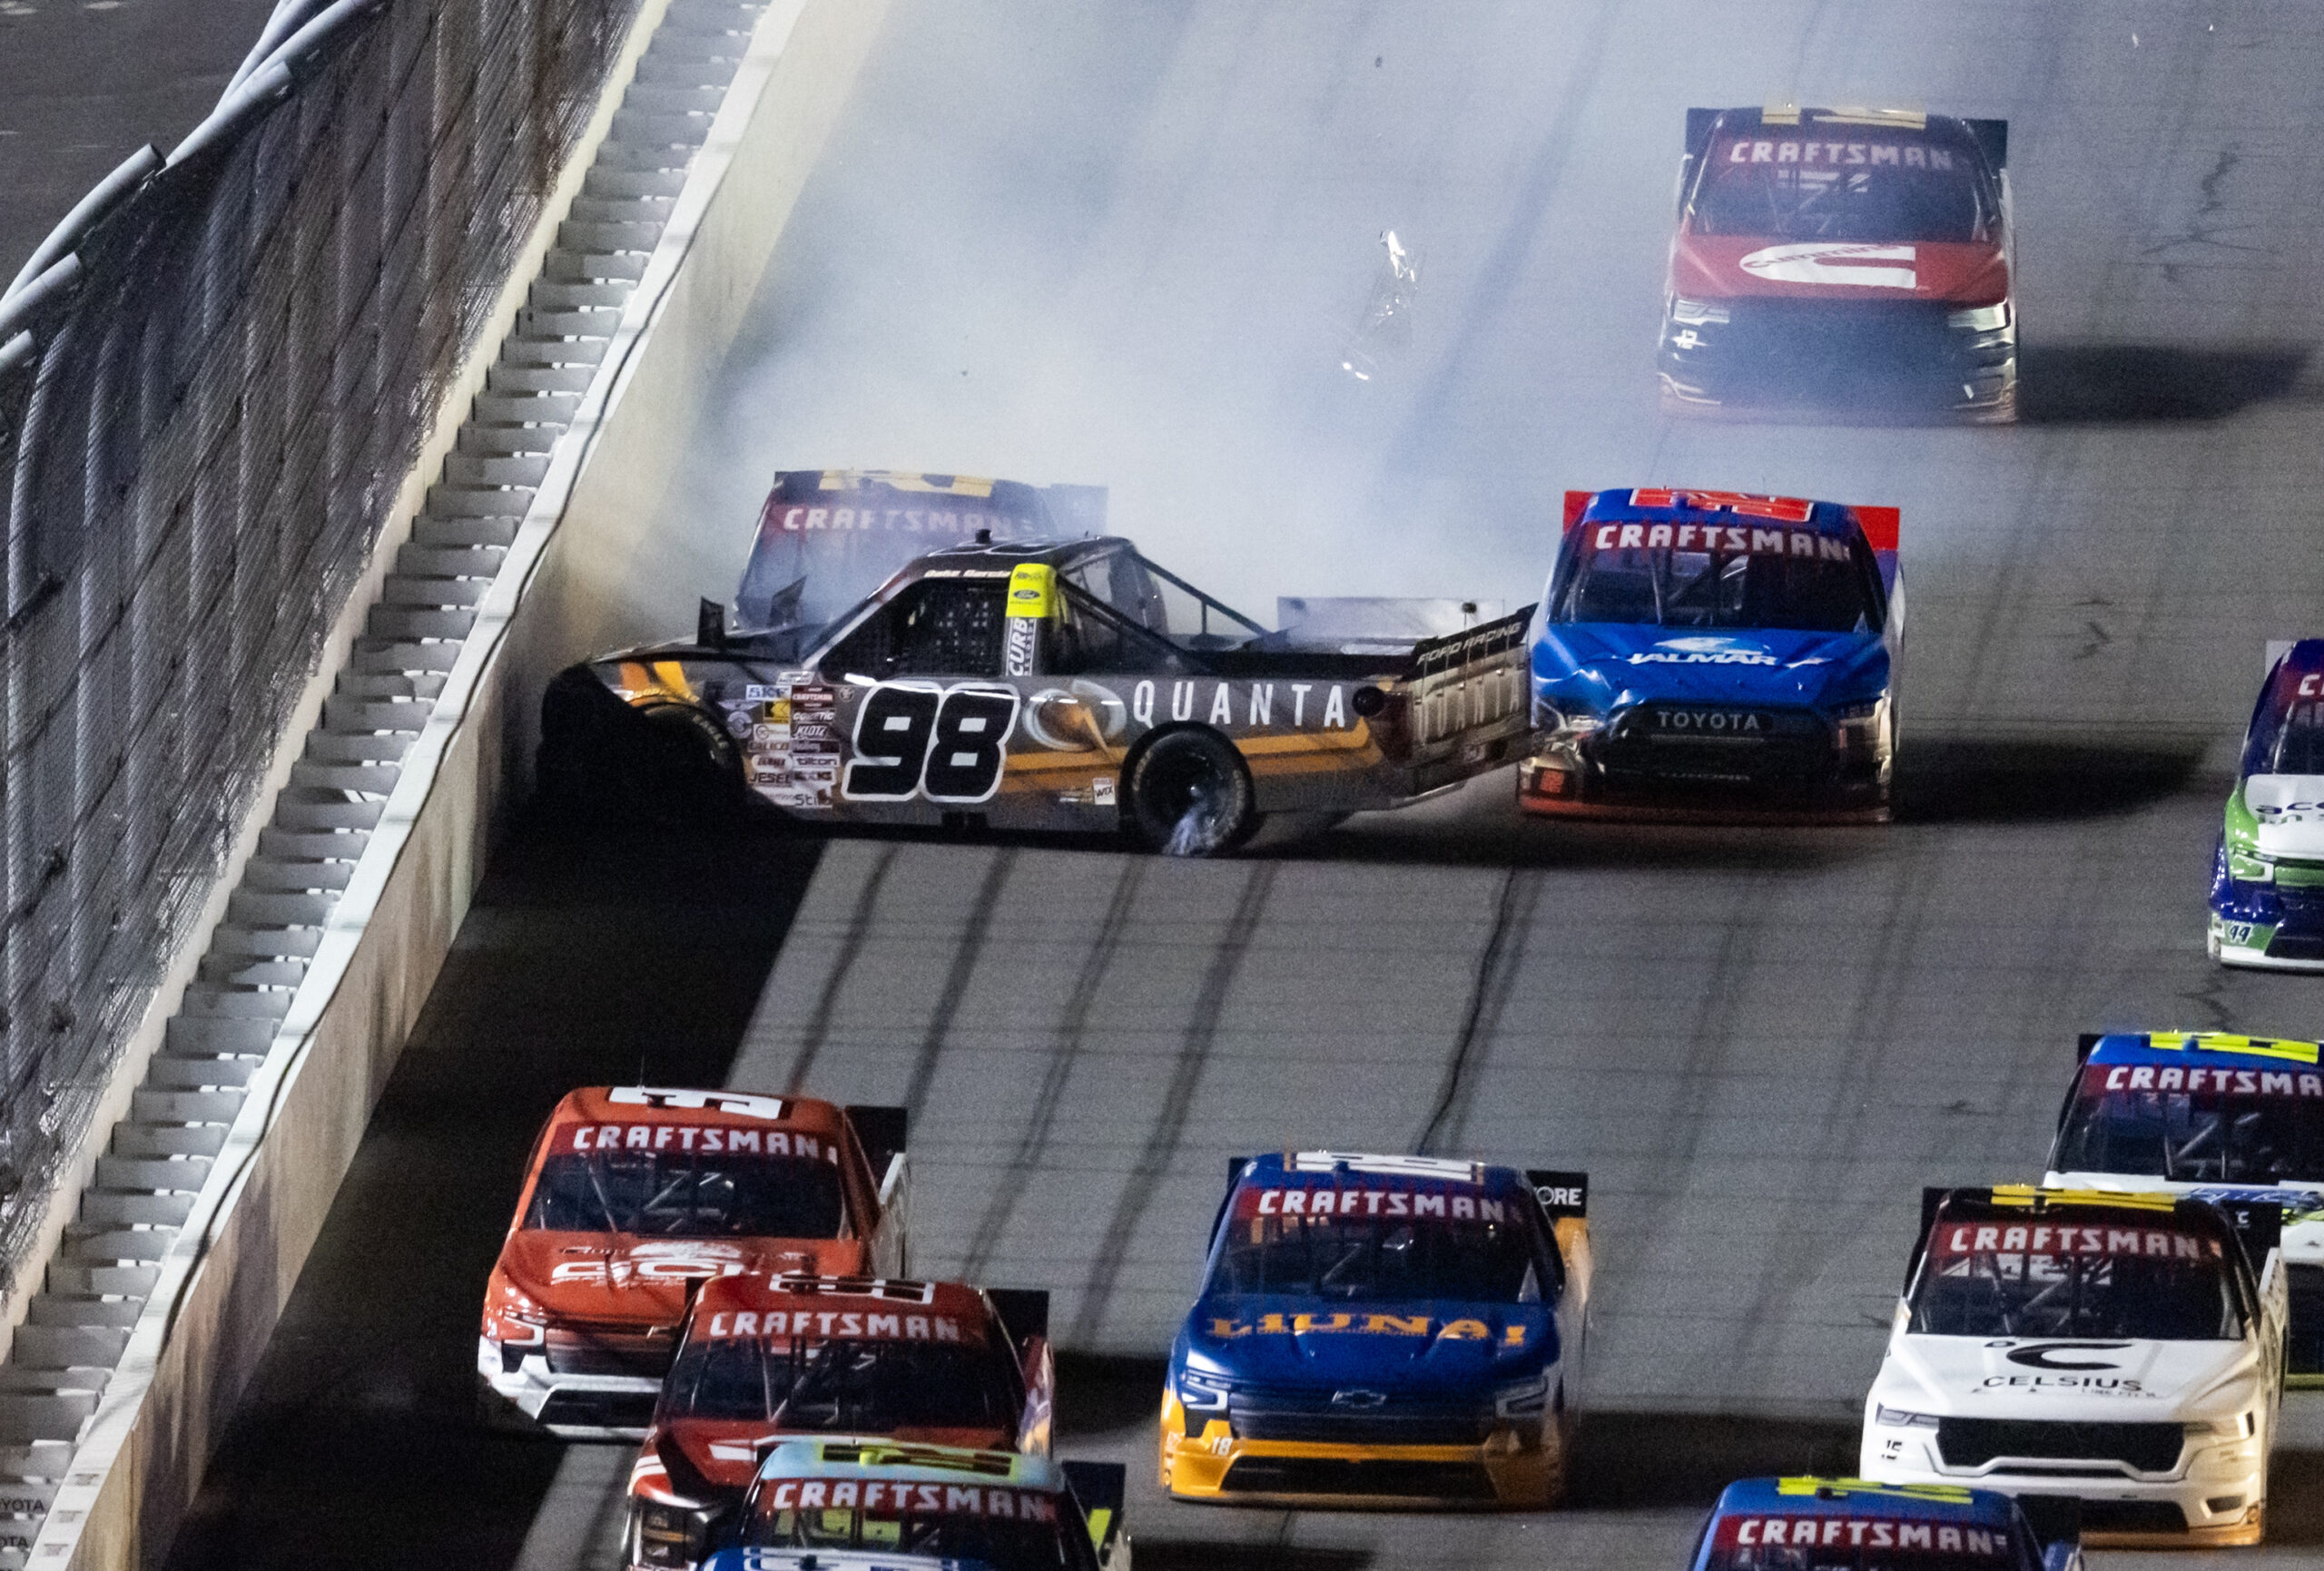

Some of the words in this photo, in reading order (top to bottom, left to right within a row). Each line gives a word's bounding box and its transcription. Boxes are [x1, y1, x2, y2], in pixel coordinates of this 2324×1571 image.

[1729, 142, 1953, 172] CRAFTSMAN
[783, 507, 1012, 535] CRAFTSMAN
[1595, 524, 1844, 560] CRAFTSMAN
[1009, 617, 1029, 677] CURB
[1133, 679, 1344, 729] QUANTA
[1657, 711, 1760, 730] TOYOTA
[842, 680, 1020, 803] 98
[748, 771, 792, 784] JESEL
[1094, 786, 1114, 799] WIX
[2105, 1065, 2324, 1096] CRAFTSMA
[574, 1126, 819, 1158] CRAFTSMAN
[1258, 1190, 1504, 1222] CRAFTSMAN
[1532, 1185, 1582, 1206] ORE
[1950, 1226, 2200, 1258] CRAFTSMAN
[710, 1311, 960, 1341] CRAFTSMAN
[1983, 1375, 2142, 1392] CELSIUS
[1212, 1437, 1234, 1456] 18
[773, 1482, 1046, 1519] CRAFTSMAN
[1737, 1519, 1993, 1555] CRAFTSMAN
